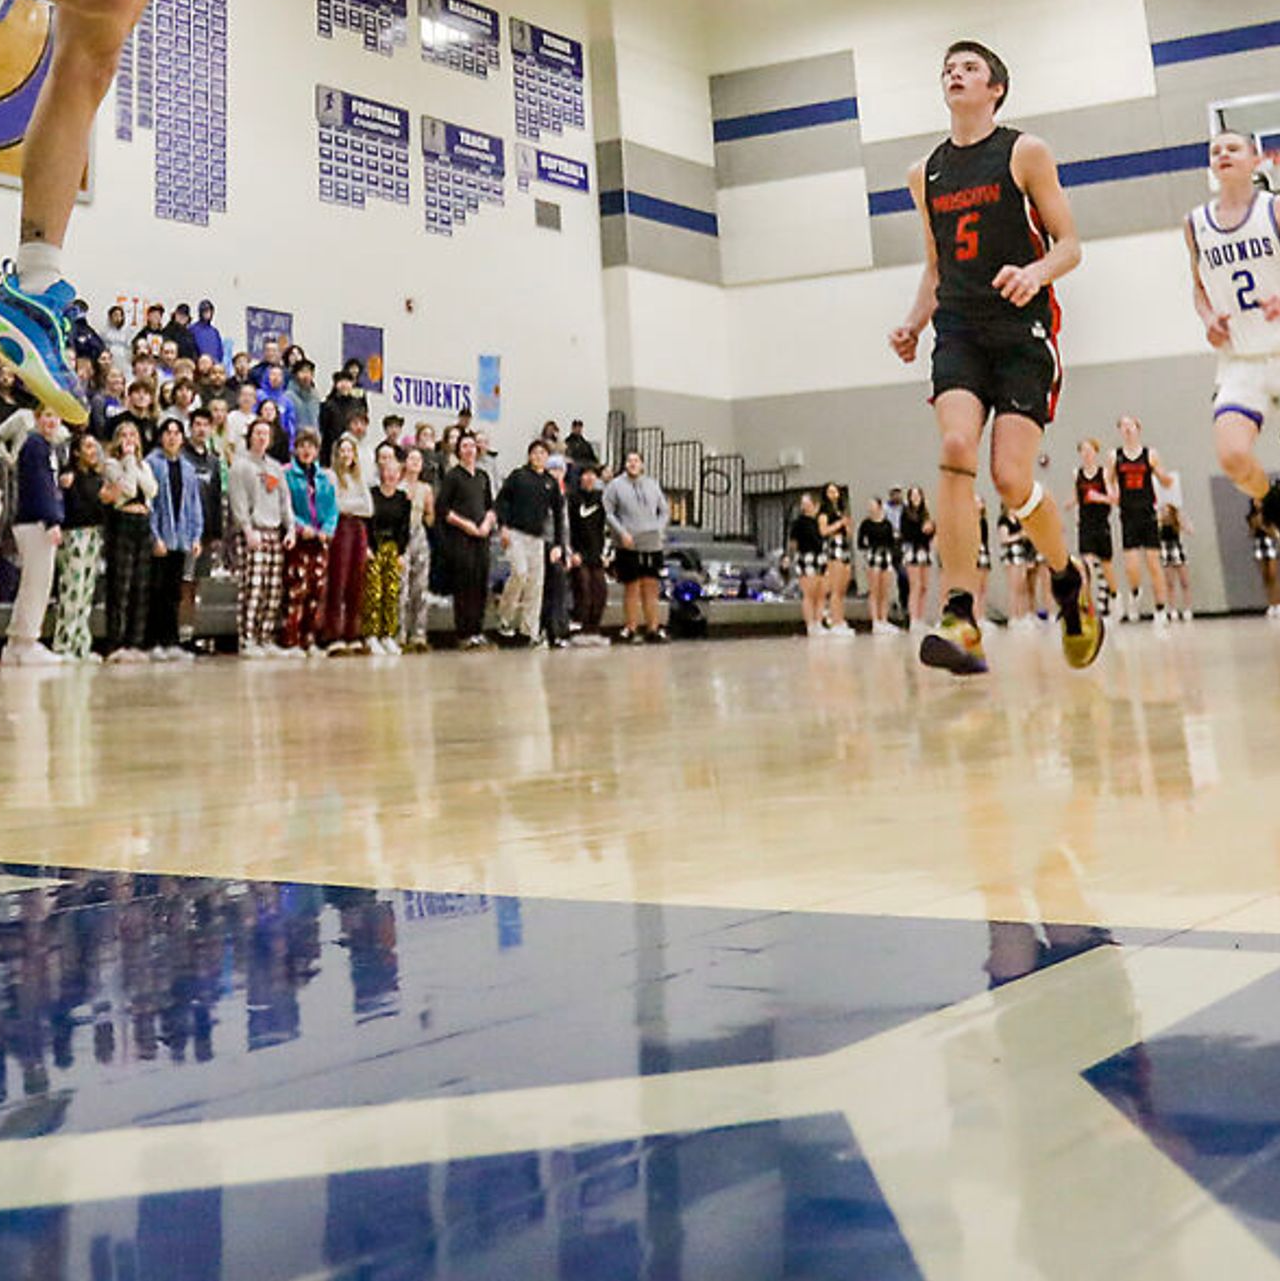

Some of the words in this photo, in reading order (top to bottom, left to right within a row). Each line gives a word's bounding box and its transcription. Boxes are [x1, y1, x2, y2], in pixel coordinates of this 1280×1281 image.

[459, 131, 491, 151] TRACK
[955, 212, 980, 261] 5
[1232, 270, 1261, 311] 2
[393, 376, 472, 410] STUDENTS
